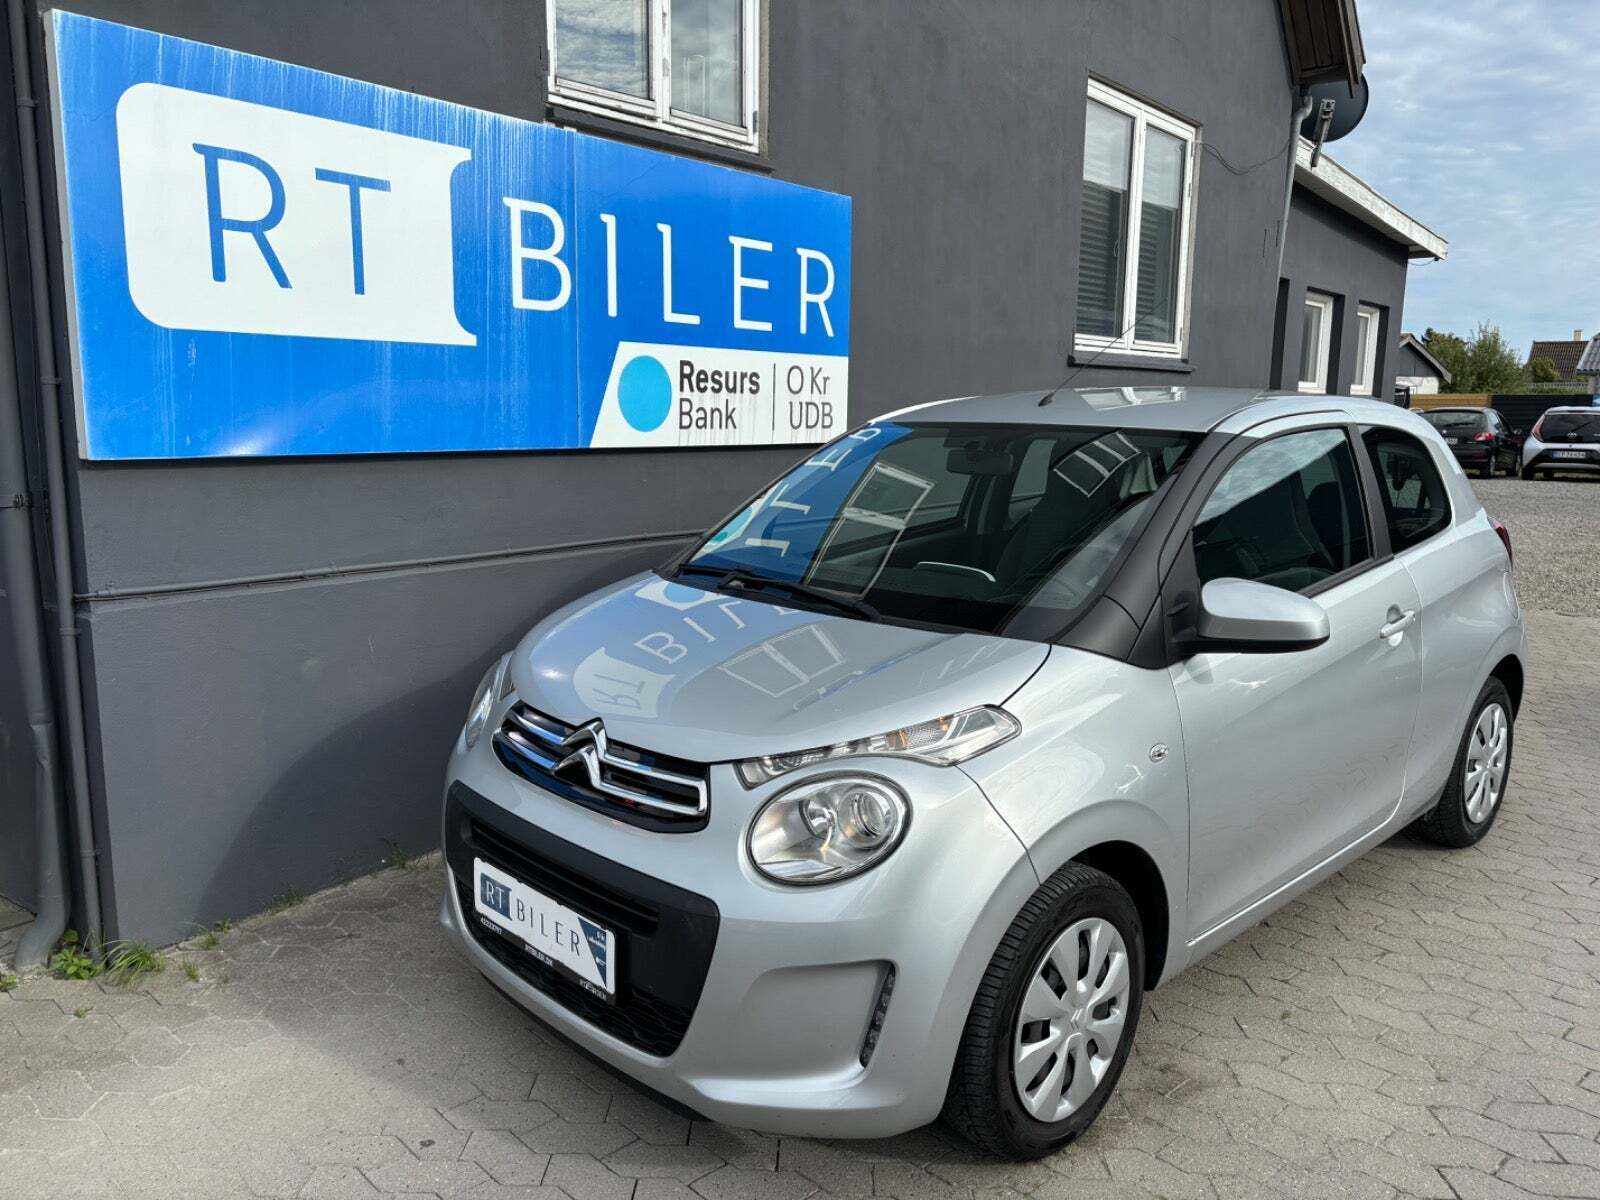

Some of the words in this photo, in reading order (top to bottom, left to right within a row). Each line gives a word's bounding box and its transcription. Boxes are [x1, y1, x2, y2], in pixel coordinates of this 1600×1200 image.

[193, 142, 391, 297] RT
[503, 196, 836, 338] BILER
[679, 359, 761, 395] Resurs
[809, 366, 831, 395] Kr
[679, 397, 737, 431] Bank
[789, 401, 833, 430] UDB
[486, 880, 505, 910] RT
[516, 898, 580, 957] BILER
